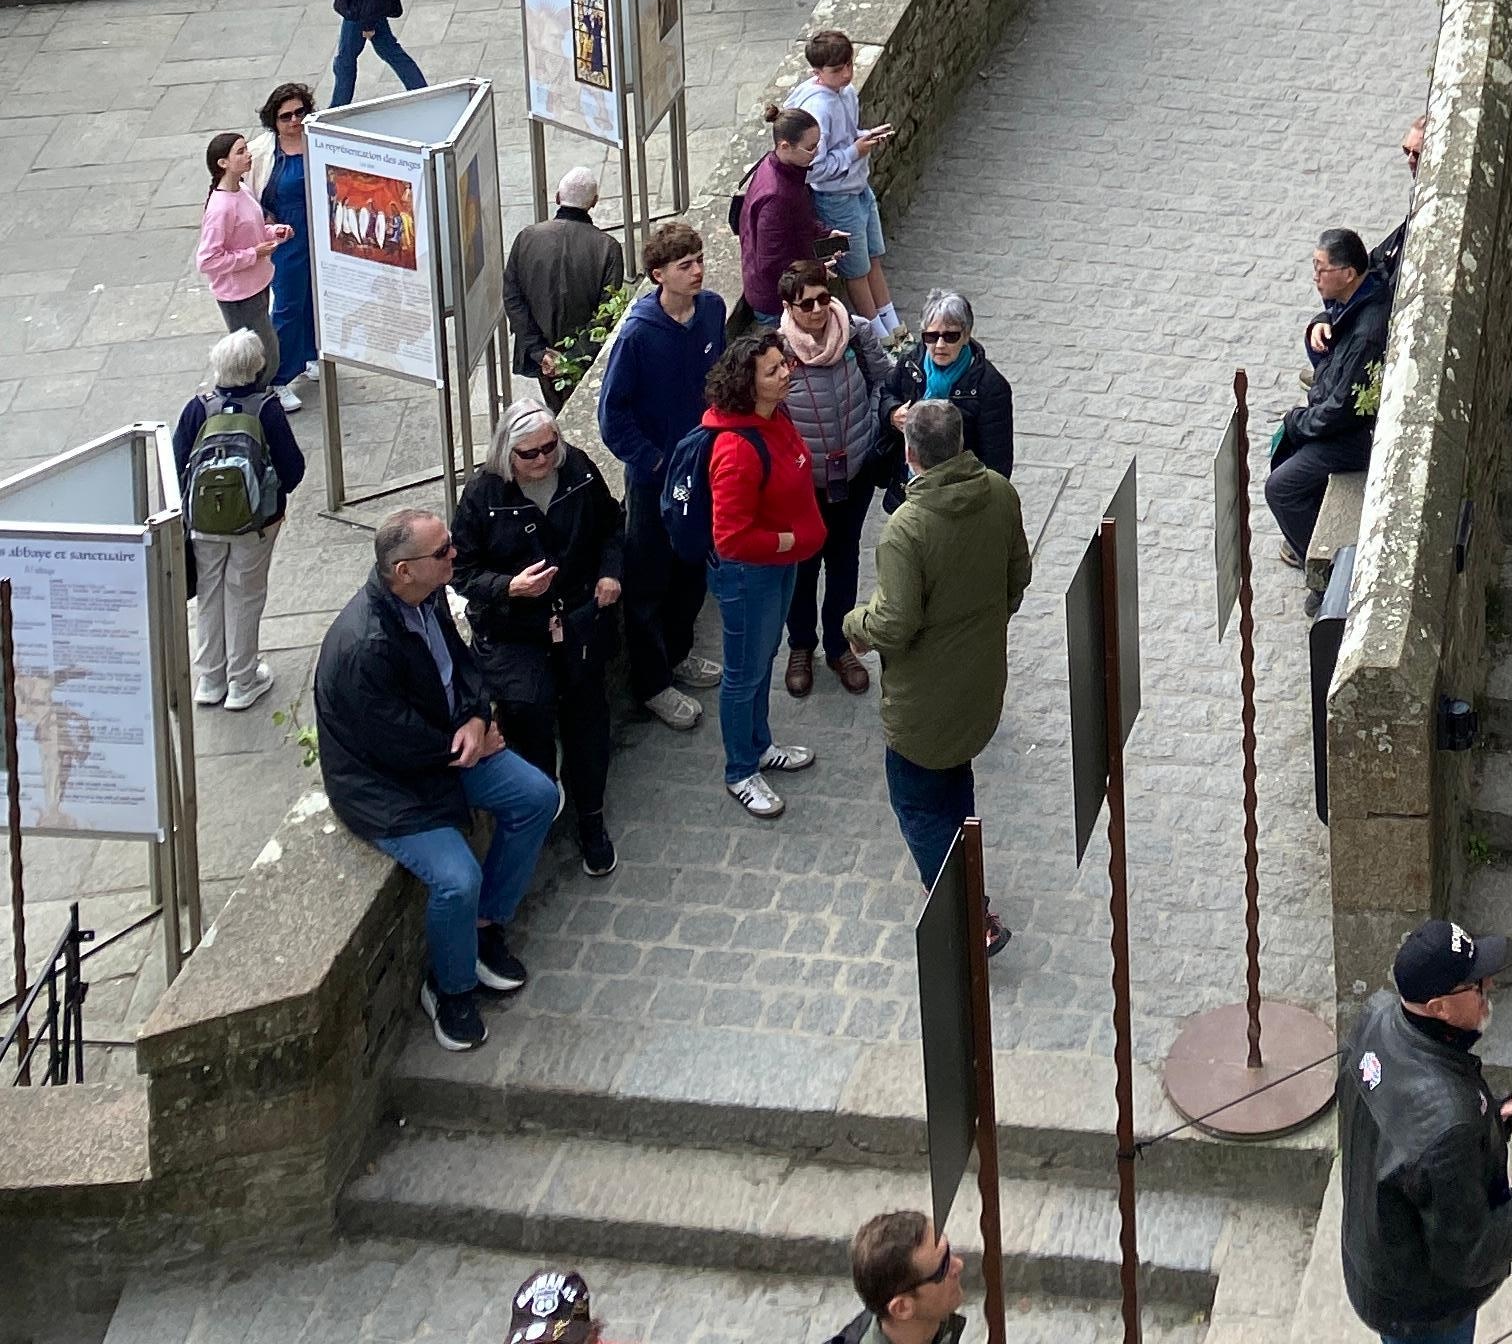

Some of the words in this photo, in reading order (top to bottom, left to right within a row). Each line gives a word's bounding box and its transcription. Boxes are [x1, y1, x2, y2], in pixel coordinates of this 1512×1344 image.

[314, 138, 324, 148] La
[383, 154, 396, 165] des
[397, 160, 421, 171] anges
[8, 545, 52, 562] abbaye
[54, 551, 66, 560] et
[70, 550, 136, 562] sanctuaire
